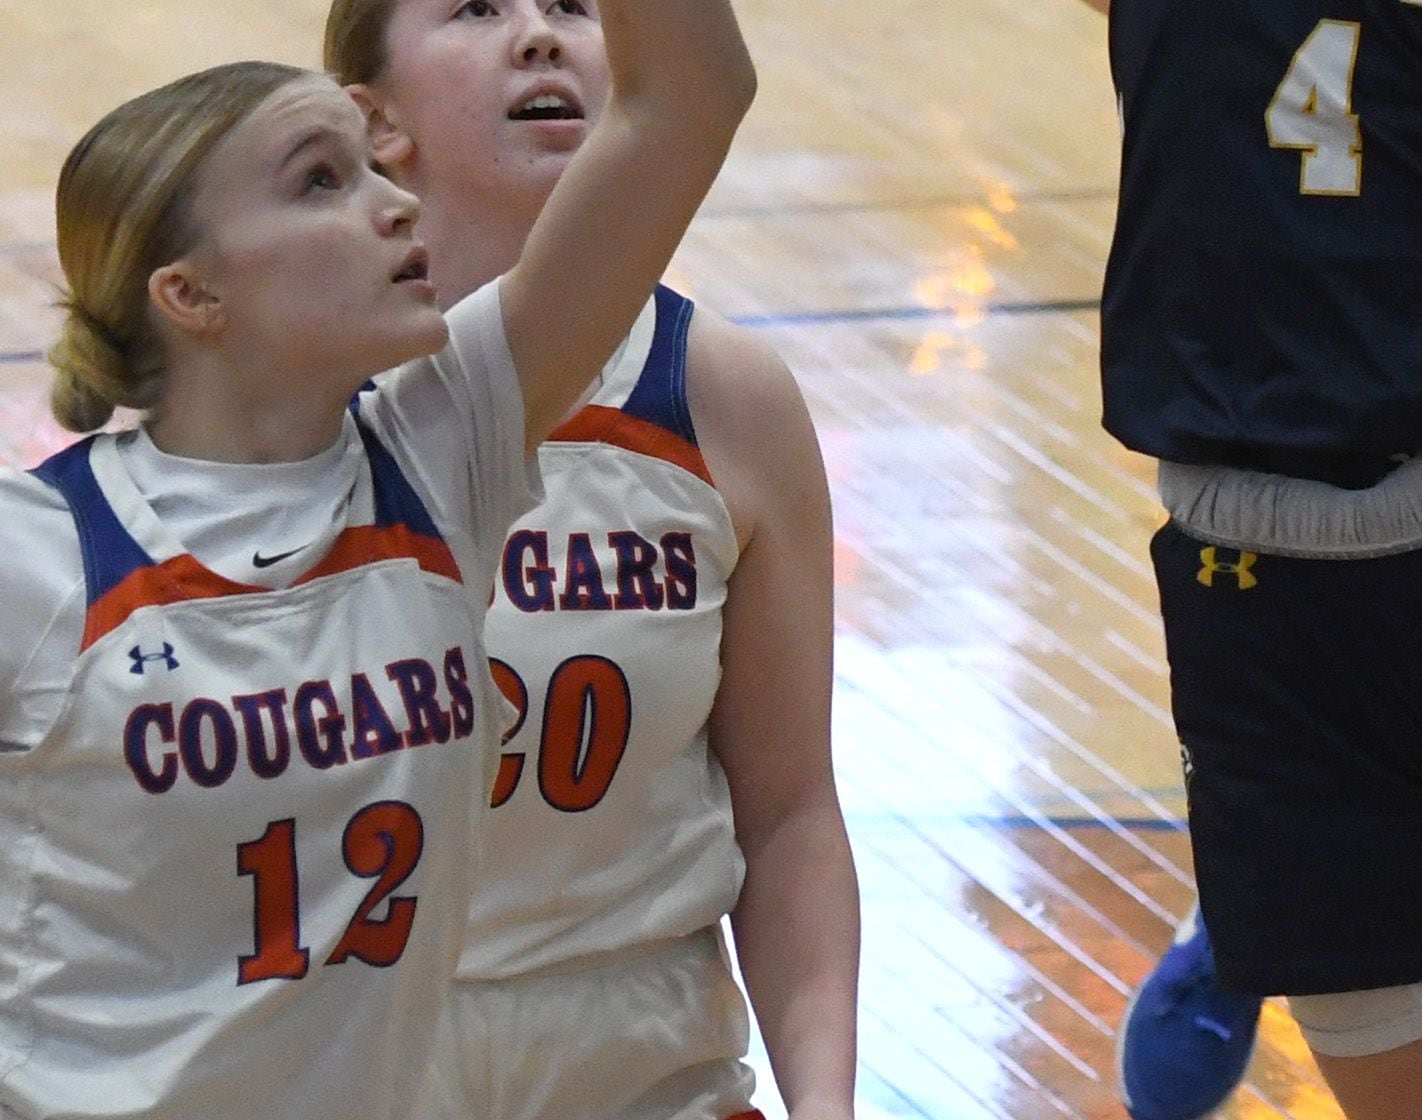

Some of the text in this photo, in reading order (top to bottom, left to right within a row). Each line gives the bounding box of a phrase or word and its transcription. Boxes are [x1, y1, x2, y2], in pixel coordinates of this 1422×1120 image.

[1263, 17, 1363, 197] 4
[488, 529, 698, 612] GARS
[122, 646, 475, 795] COUGARS
[236, 799, 425, 987] 12
